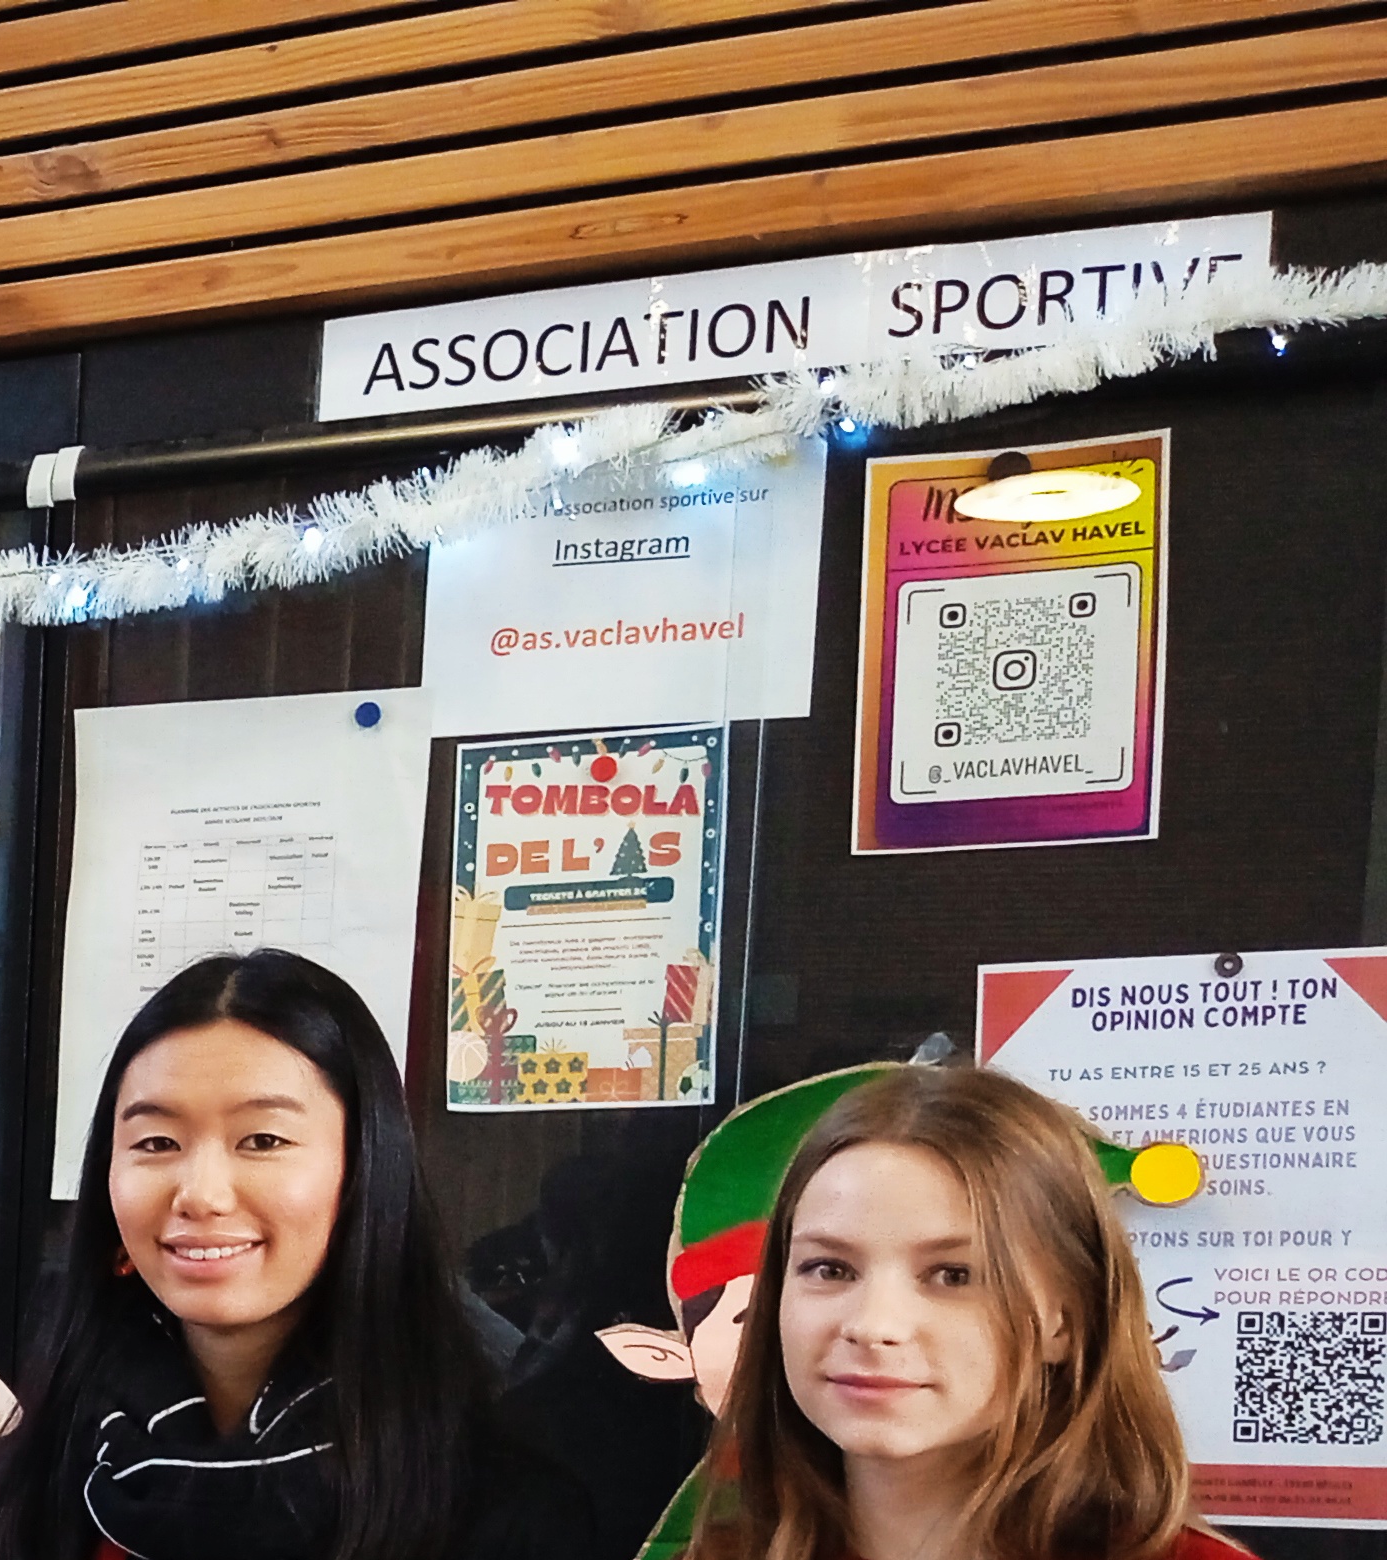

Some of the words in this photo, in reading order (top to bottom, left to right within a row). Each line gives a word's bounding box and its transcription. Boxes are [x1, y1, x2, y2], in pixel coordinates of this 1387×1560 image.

[361, 295, 812, 396] ASSOCIATION
[660, 487, 734, 513] sportive
[740, 486, 769, 504] sur
[554, 533, 690, 563] Instagram
[975, 528, 1066, 551] VACLAV
[1072, 520, 1145, 543] HAVEL
[489, 612, 745, 657] @as.vaclavhavel
[484, 784, 701, 817] TOMBOLA
[485, 839, 550, 877] DE
[1071, 985, 1111, 1009] DIS
[1120, 982, 1190, 1007] NOUS
[1199, 979, 1263, 1004] TOUT
[1287, 976, 1339, 1001] TON
[1091, 1004, 1195, 1032] OPINION
[1204, 1003, 1308, 1028] COMPTE
[1050, 1067, 1072, 1082] TU
[1079, 1066, 1104, 1081] AS
[1111, 1064, 1175, 1080] ENTRE
[1182, 1064, 1200, 1078] 15
[1208, 1063, 1230, 1078] ET
[1238, 1062, 1262, 1076] 25
[1268, 1060, 1310, 1076] ANS
[1088, 1103, 1170, 1122] SOMMES
[1176, 1102, 1188, 1120] 4
[1194, 1098, 1316, 1120] ÉTUDIANTES
[1324, 1099, 1350, 1117] EN
[1111, 1130, 1134, 1145] ET
[1140, 1127, 1249, 1147] AIMERIONS
[1255, 1126, 1297, 1145] QUE
[1304, 1125, 1356, 1143] VOUS
[1197, 1230, 1235, 1248] SUR
[1242, 1230, 1273, 1247] TOI
[1280, 1229, 1332, 1247] POUR
[1341, 1229, 1353, 1246] Y
[1214, 1267, 1270, 1282] VOICI
[1277, 1267, 1300, 1282] LE
[1308, 1267, 1337, 1283] QR
[1214, 1291, 1271, 1306] POUR
[1278, 1288, 1387, 1305] RÉPONDR
